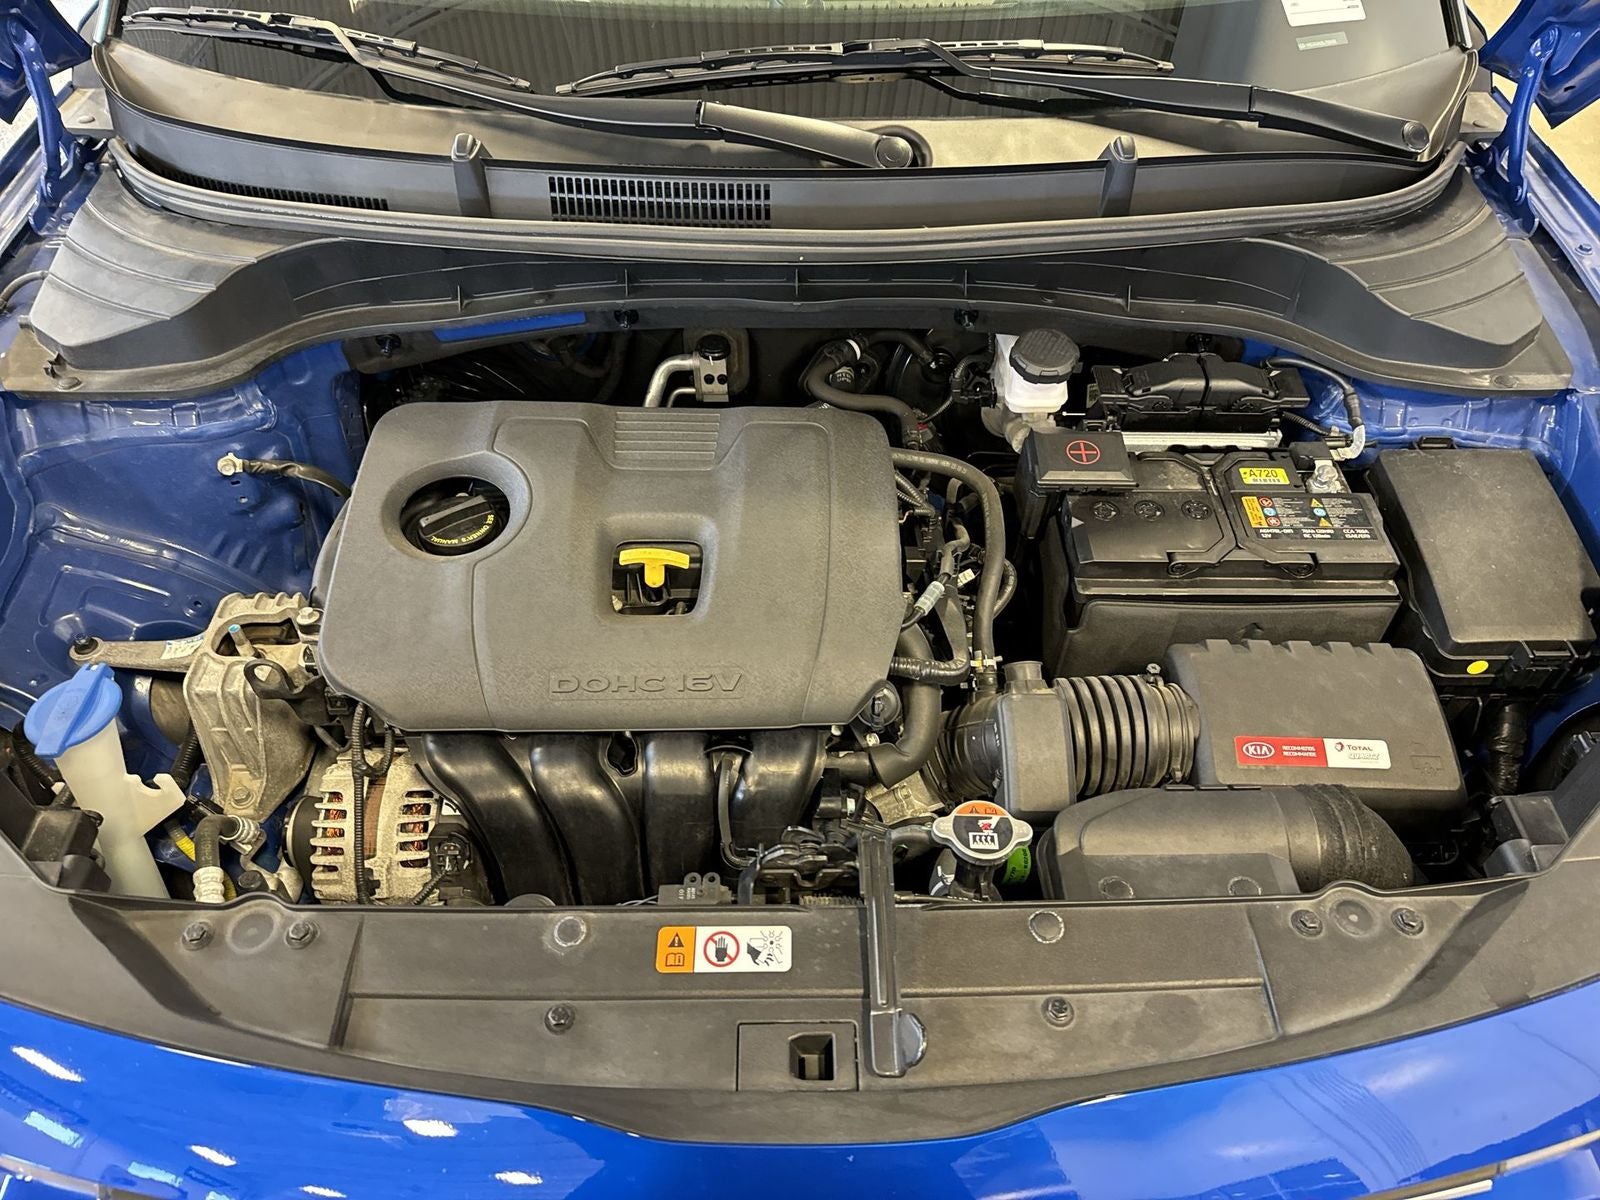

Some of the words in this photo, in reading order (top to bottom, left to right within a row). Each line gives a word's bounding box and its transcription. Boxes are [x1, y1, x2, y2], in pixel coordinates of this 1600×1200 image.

[1248, 469, 1278, 478] A720
[485, 514, 495, 525] SEE
[461, 525, 489, 542] OWNER'S
[430, 535, 459, 544] MANUAL
[551, 674, 666, 694] DOHC
[677, 672, 743, 693] 16V
[1247, 744, 1270, 755] KIA
[1346, 743, 1373, 752] TOTAL
